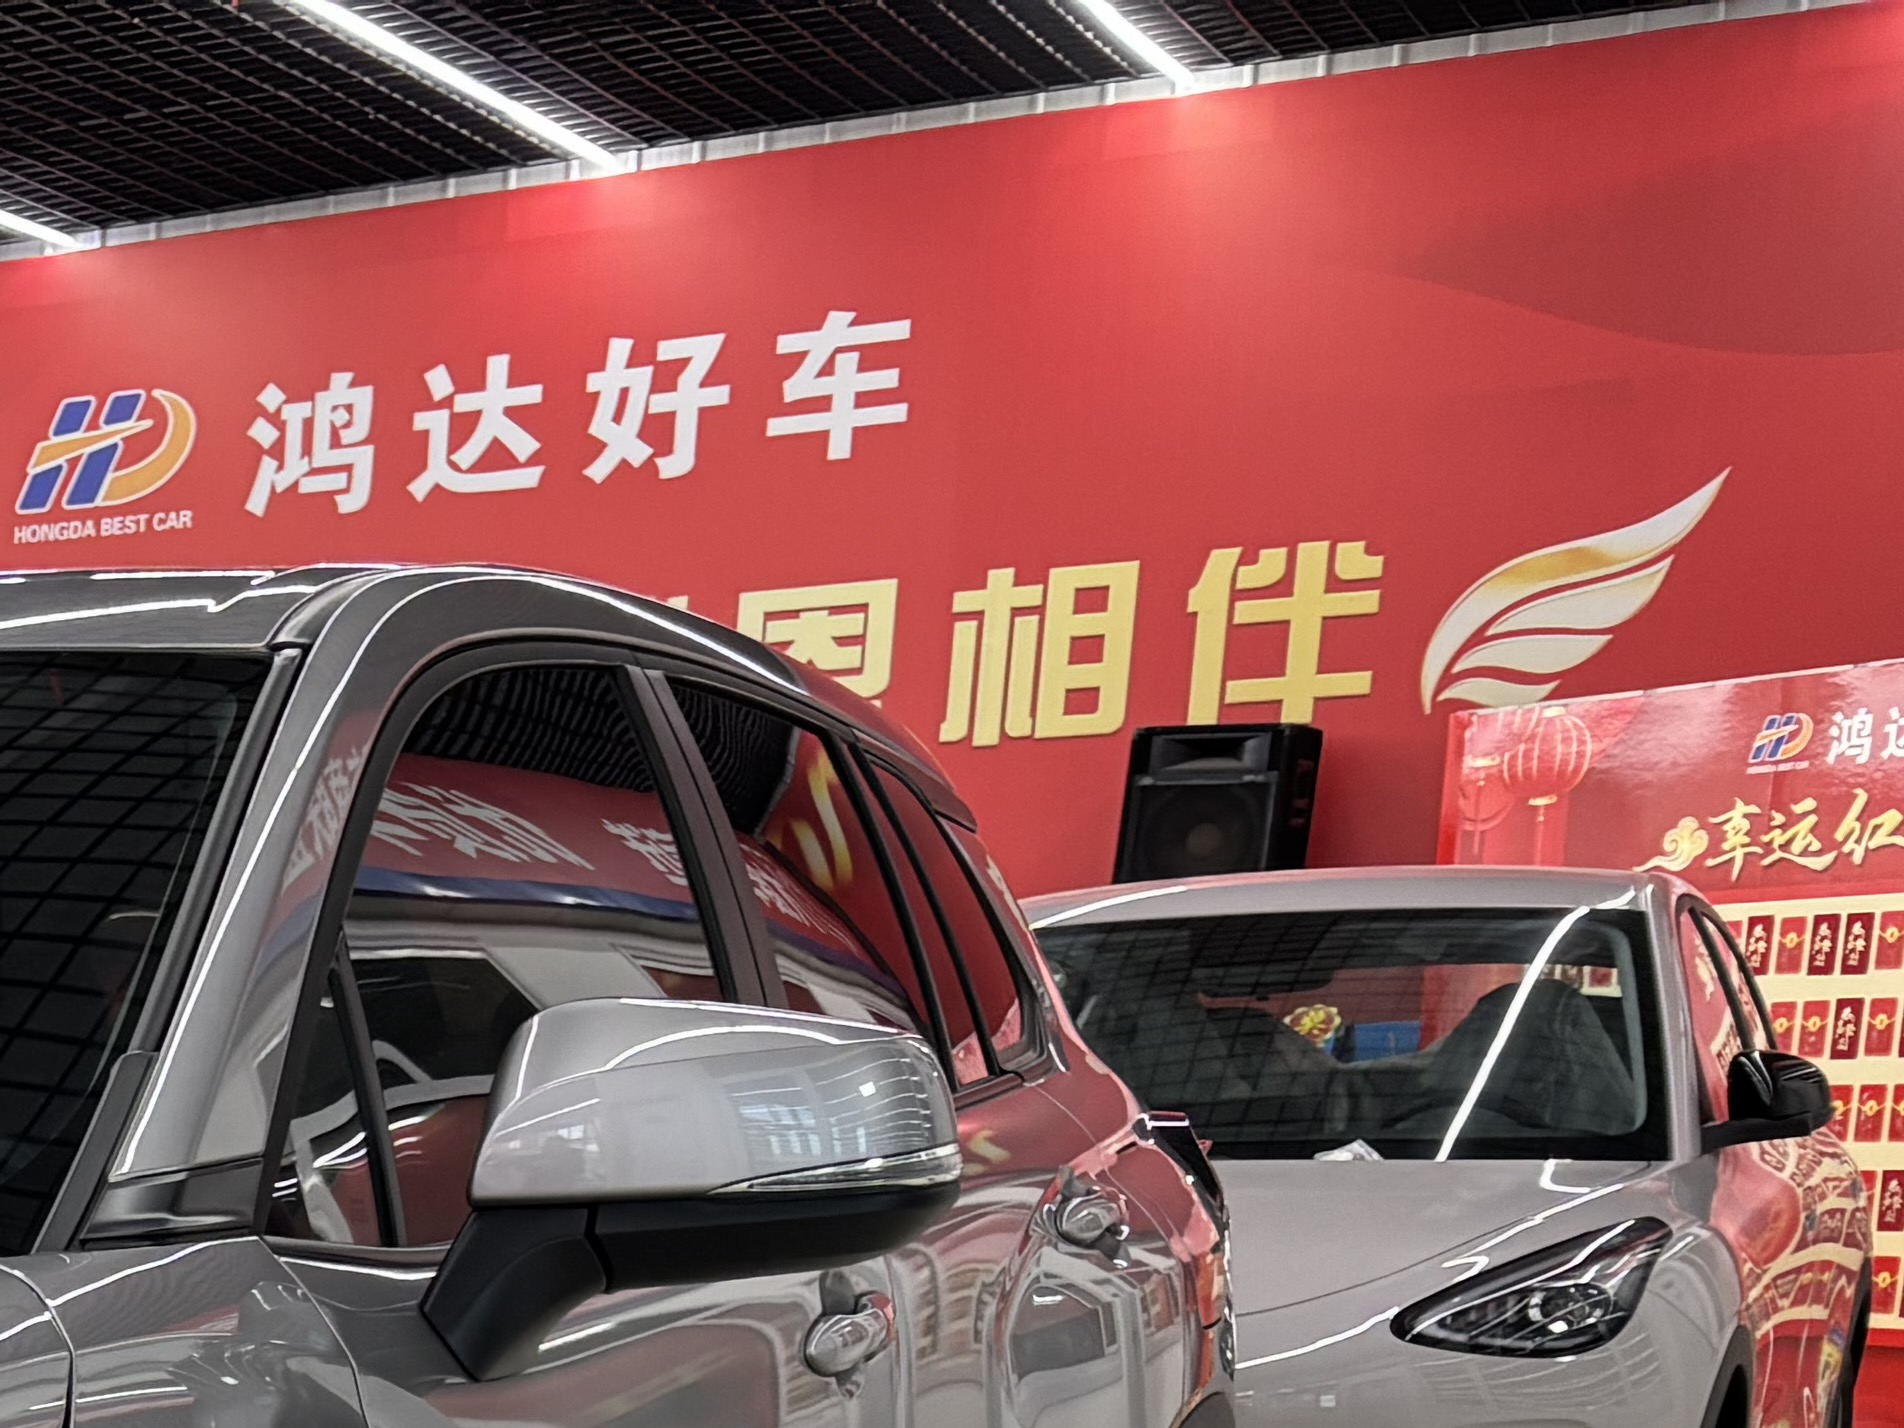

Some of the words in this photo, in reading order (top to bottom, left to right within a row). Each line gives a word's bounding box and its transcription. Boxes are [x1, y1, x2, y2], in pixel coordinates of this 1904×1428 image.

[245, 311, 911, 516] 鸿达好车
[13, 520, 96, 544] HONGDA
[100, 513, 149, 536] BEST
[152, 510, 192, 531] CAR
[666, 541, 1384, 746] 恩相伴
